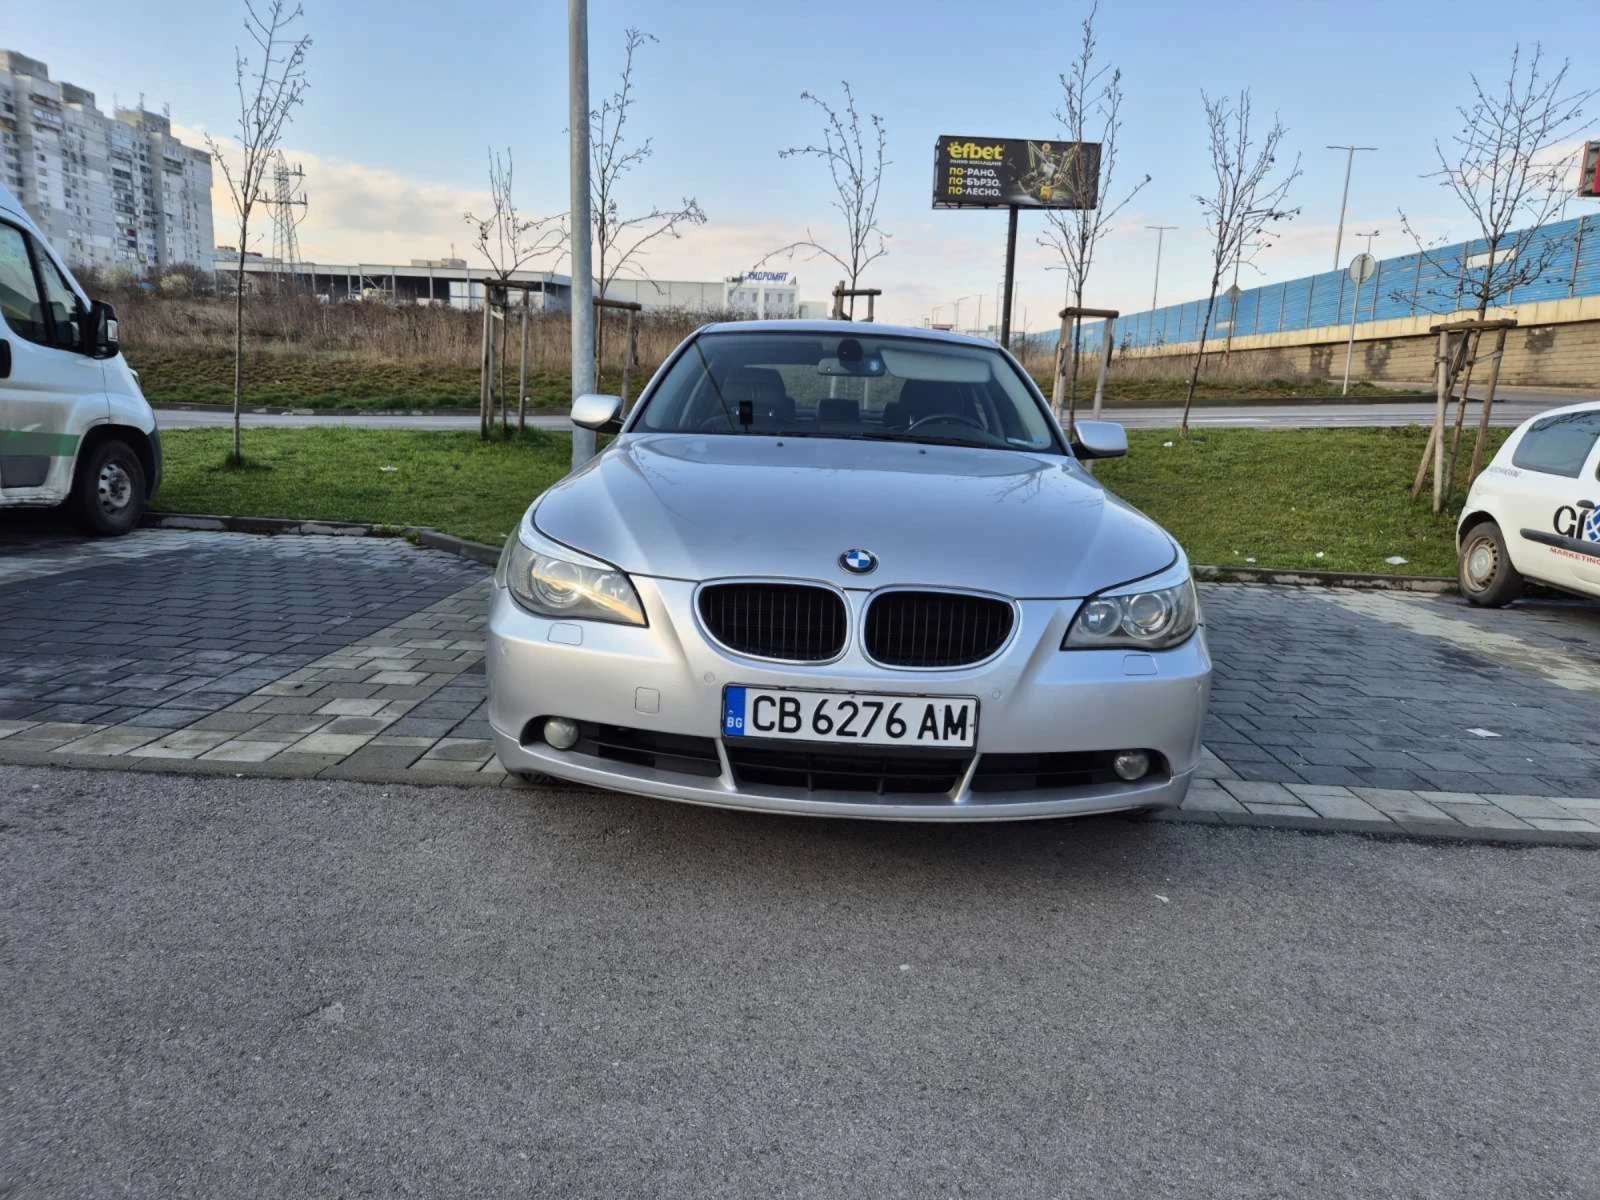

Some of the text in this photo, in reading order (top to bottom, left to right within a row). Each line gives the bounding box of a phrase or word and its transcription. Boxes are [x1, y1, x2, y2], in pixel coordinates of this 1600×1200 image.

[949, 143, 1003, 160] efbet
[949, 167, 997, 177] ПО-РАНО.
[949, 177, 1001, 187] ПО-БЪРЗО.
[948, 186, 1001, 197] ПО-ЛЕСНО.
[727, 716, 743, 729] BG
[752, 695, 968, 741] CB 6276 AM
